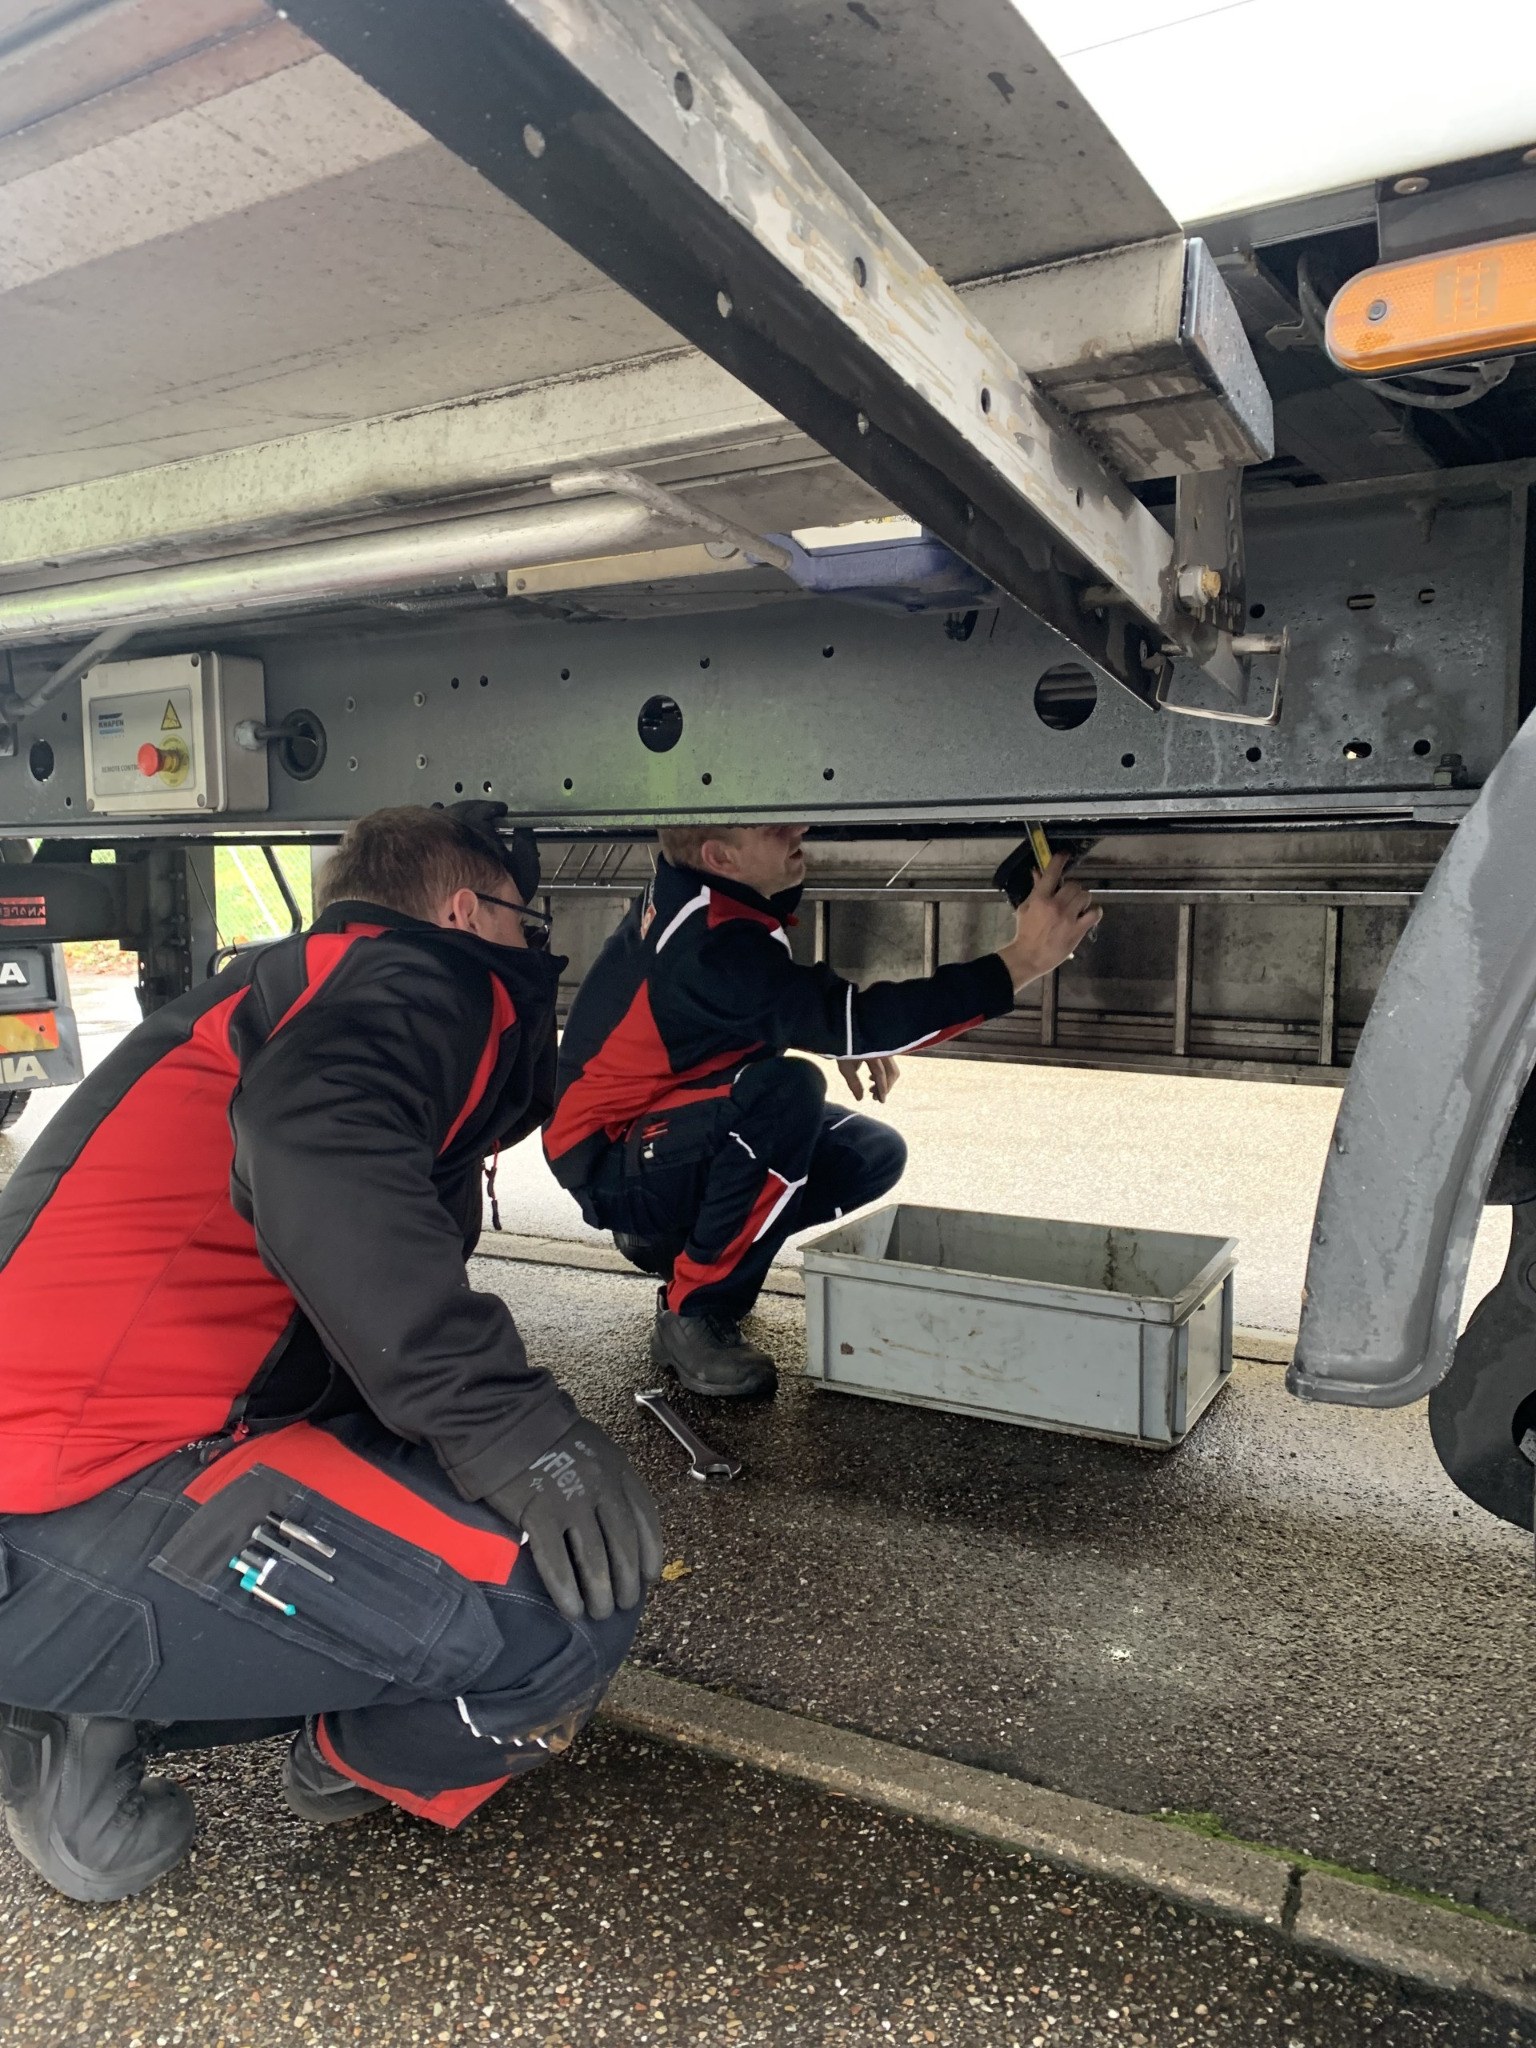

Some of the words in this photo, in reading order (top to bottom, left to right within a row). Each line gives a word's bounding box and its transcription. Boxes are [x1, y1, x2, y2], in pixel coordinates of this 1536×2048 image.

[98, 719, 124, 728] KNAPEN
[120, 764, 139, 772] CONTR
[0, 962, 28, 984] A
[0, 1055, 49, 1084] IA
[528, 1451, 585, 1501] yFlex
